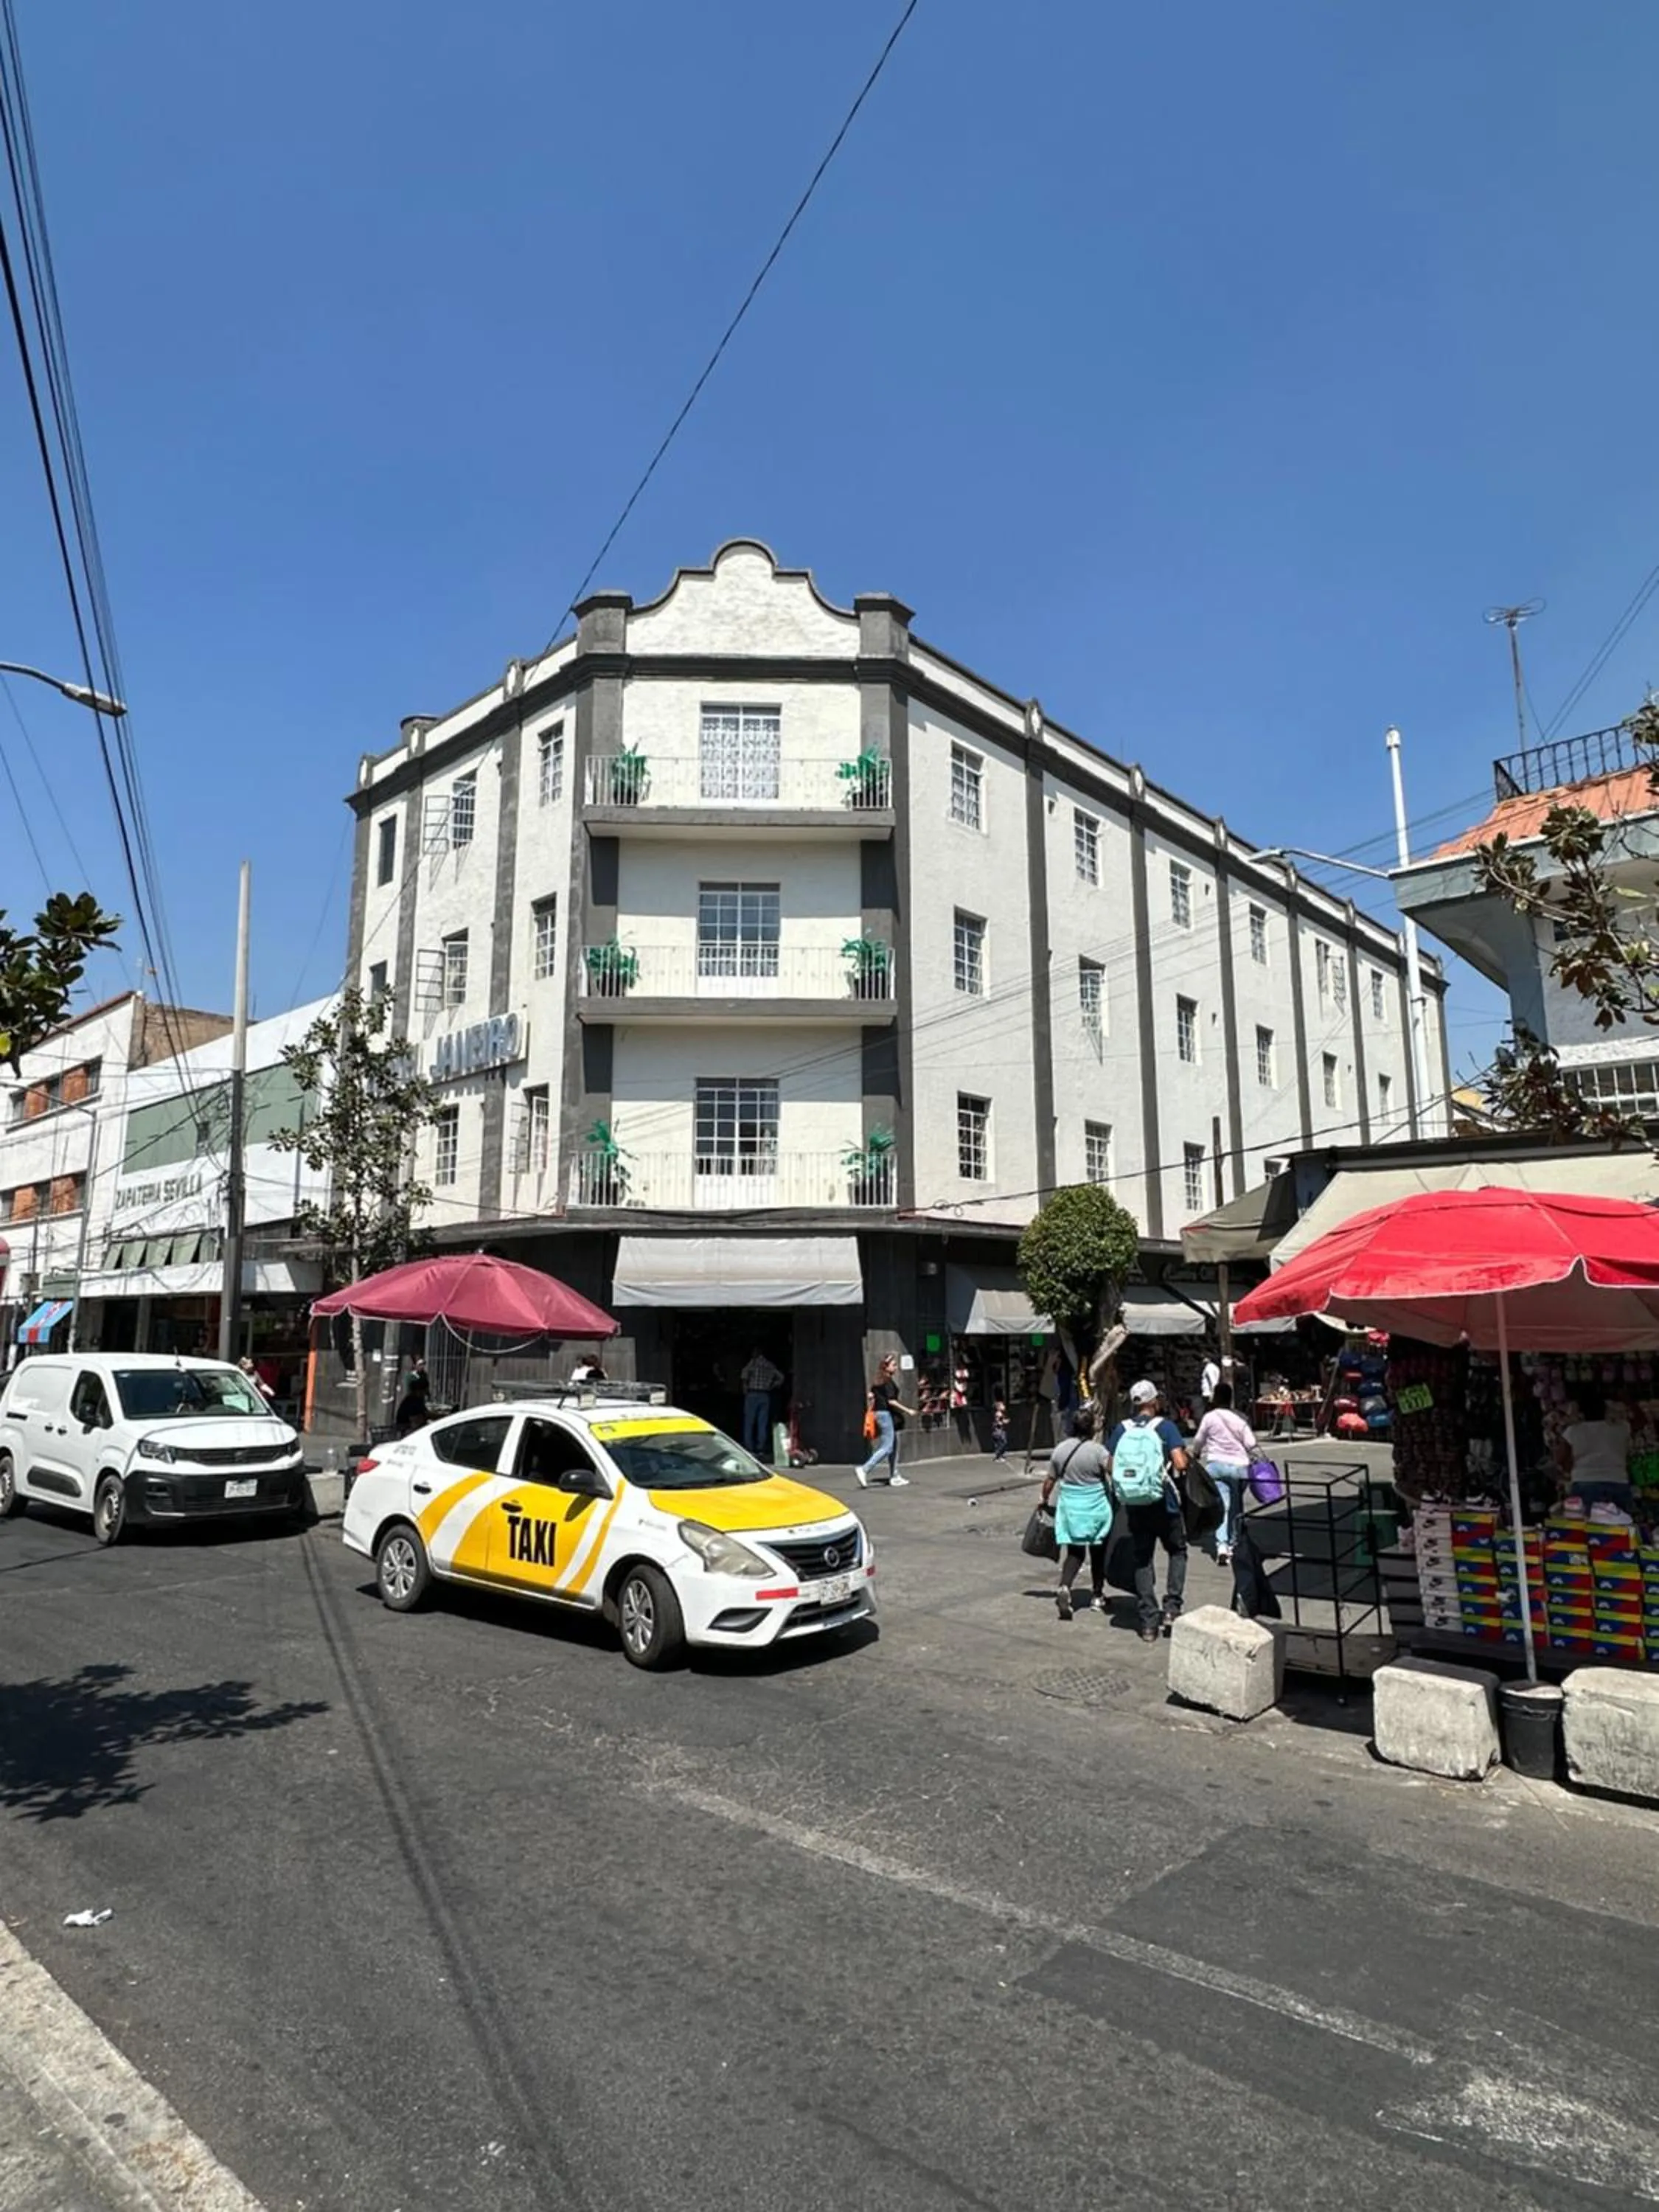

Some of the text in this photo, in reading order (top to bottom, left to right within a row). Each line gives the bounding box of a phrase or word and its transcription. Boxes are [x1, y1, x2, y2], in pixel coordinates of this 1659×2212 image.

[430, 1013, 522, 1082] JANEIRO
[116, 1172, 201, 1209] ZAPATERIA SEVILLA
[507, 1515, 557, 1568] TAXI
